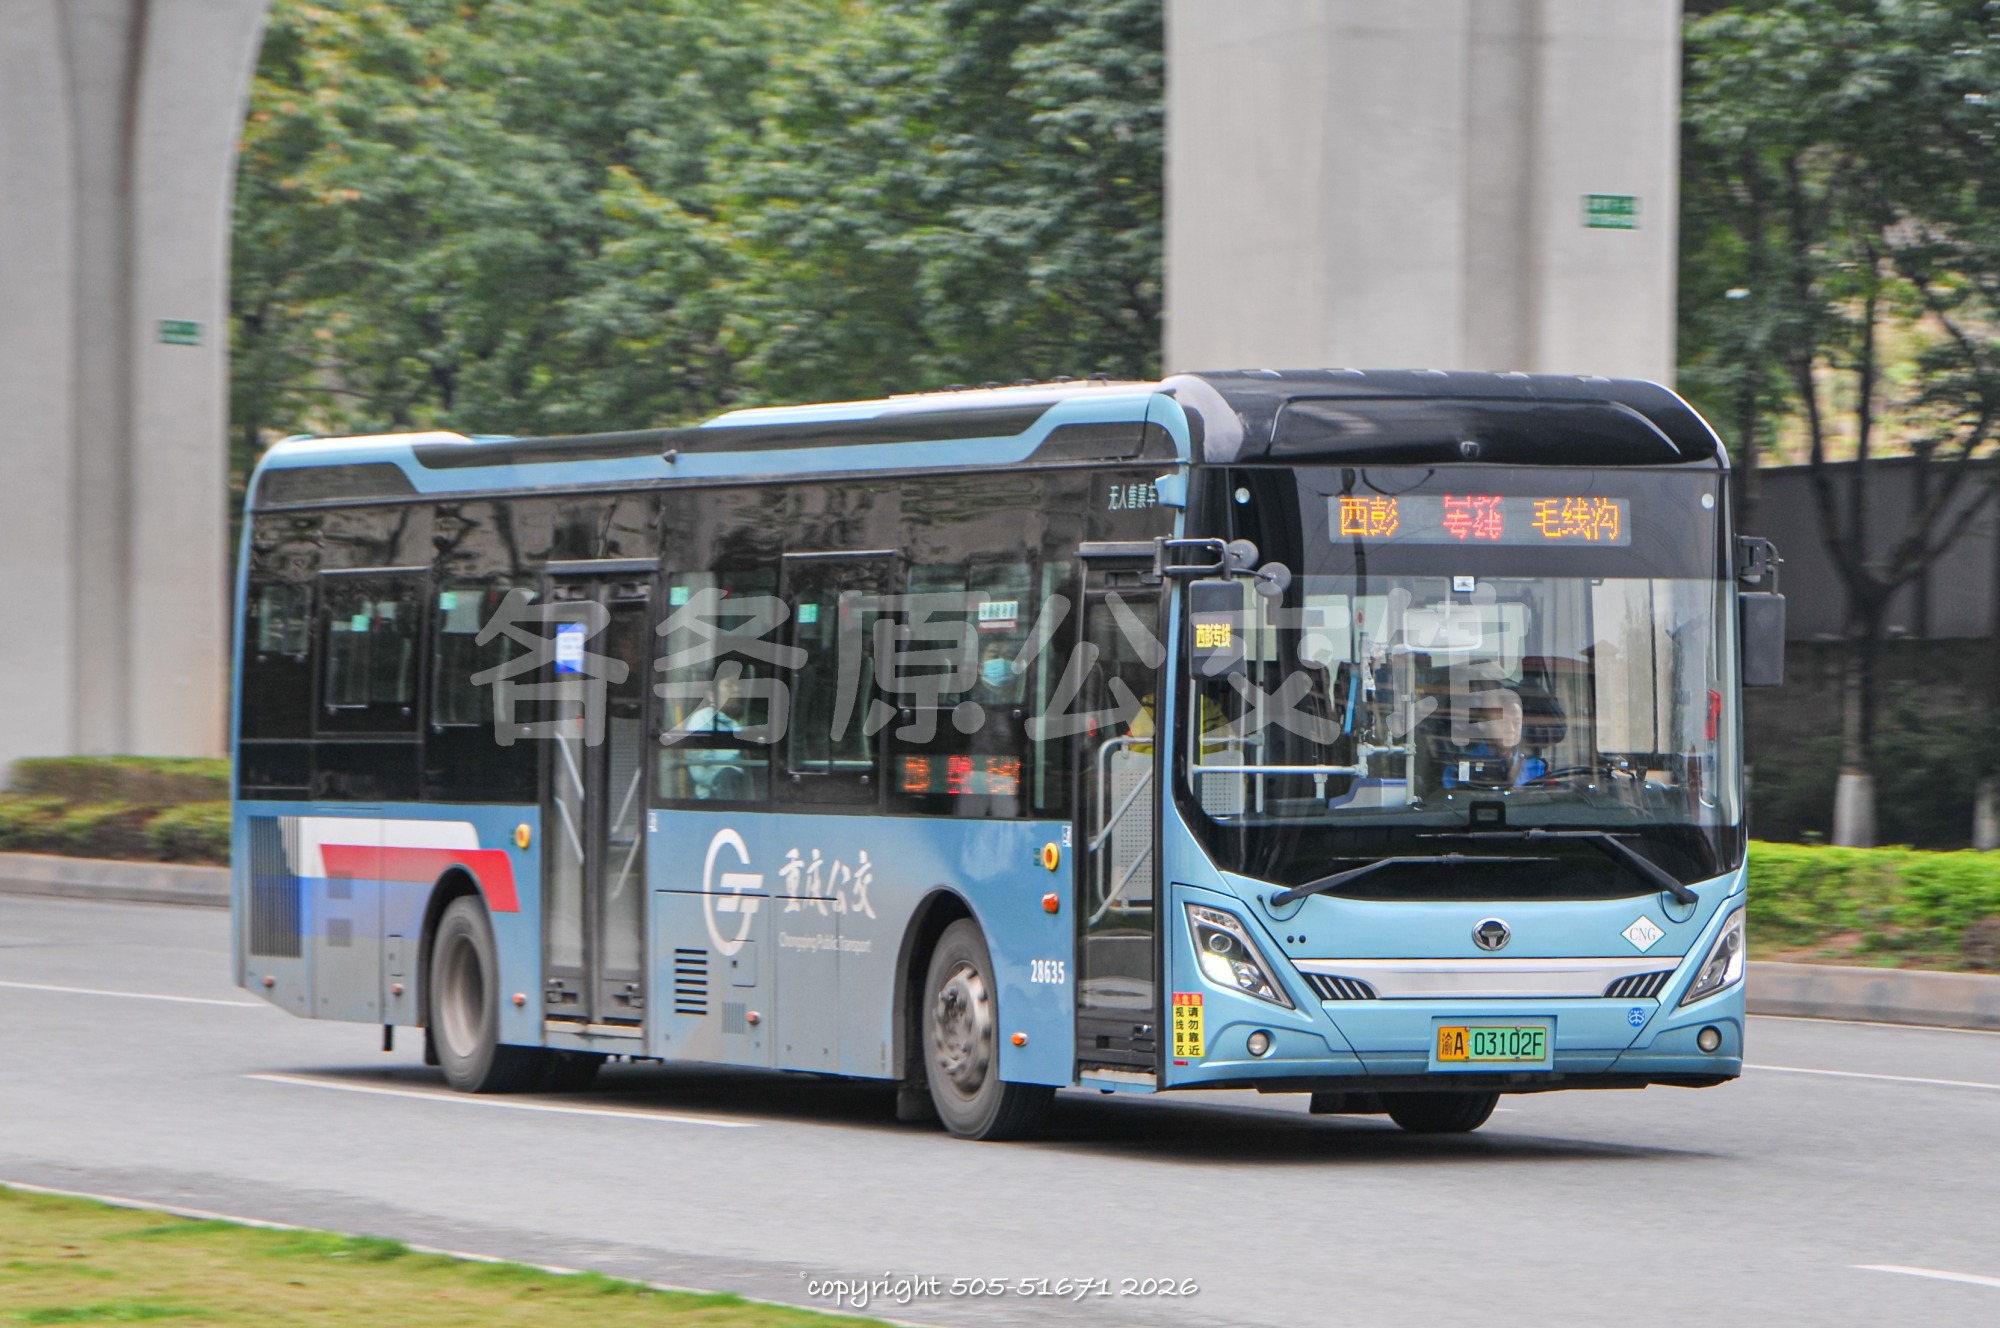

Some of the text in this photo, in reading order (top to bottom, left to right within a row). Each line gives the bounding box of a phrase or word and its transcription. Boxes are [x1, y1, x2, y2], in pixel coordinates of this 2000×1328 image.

[1339, 496, 1399, 536] 西彭
[1531, 497, 1620, 540] 毛线沟
[778, 847, 877, 919] 重庆公交
[1629, 927, 1656, 941] CNG
[1030, 960, 1065, 984] 28635
[1175, 1006, 1185, 1056] 视线盲区
[1187, 1006, 1201, 1056] 请勿靠近
